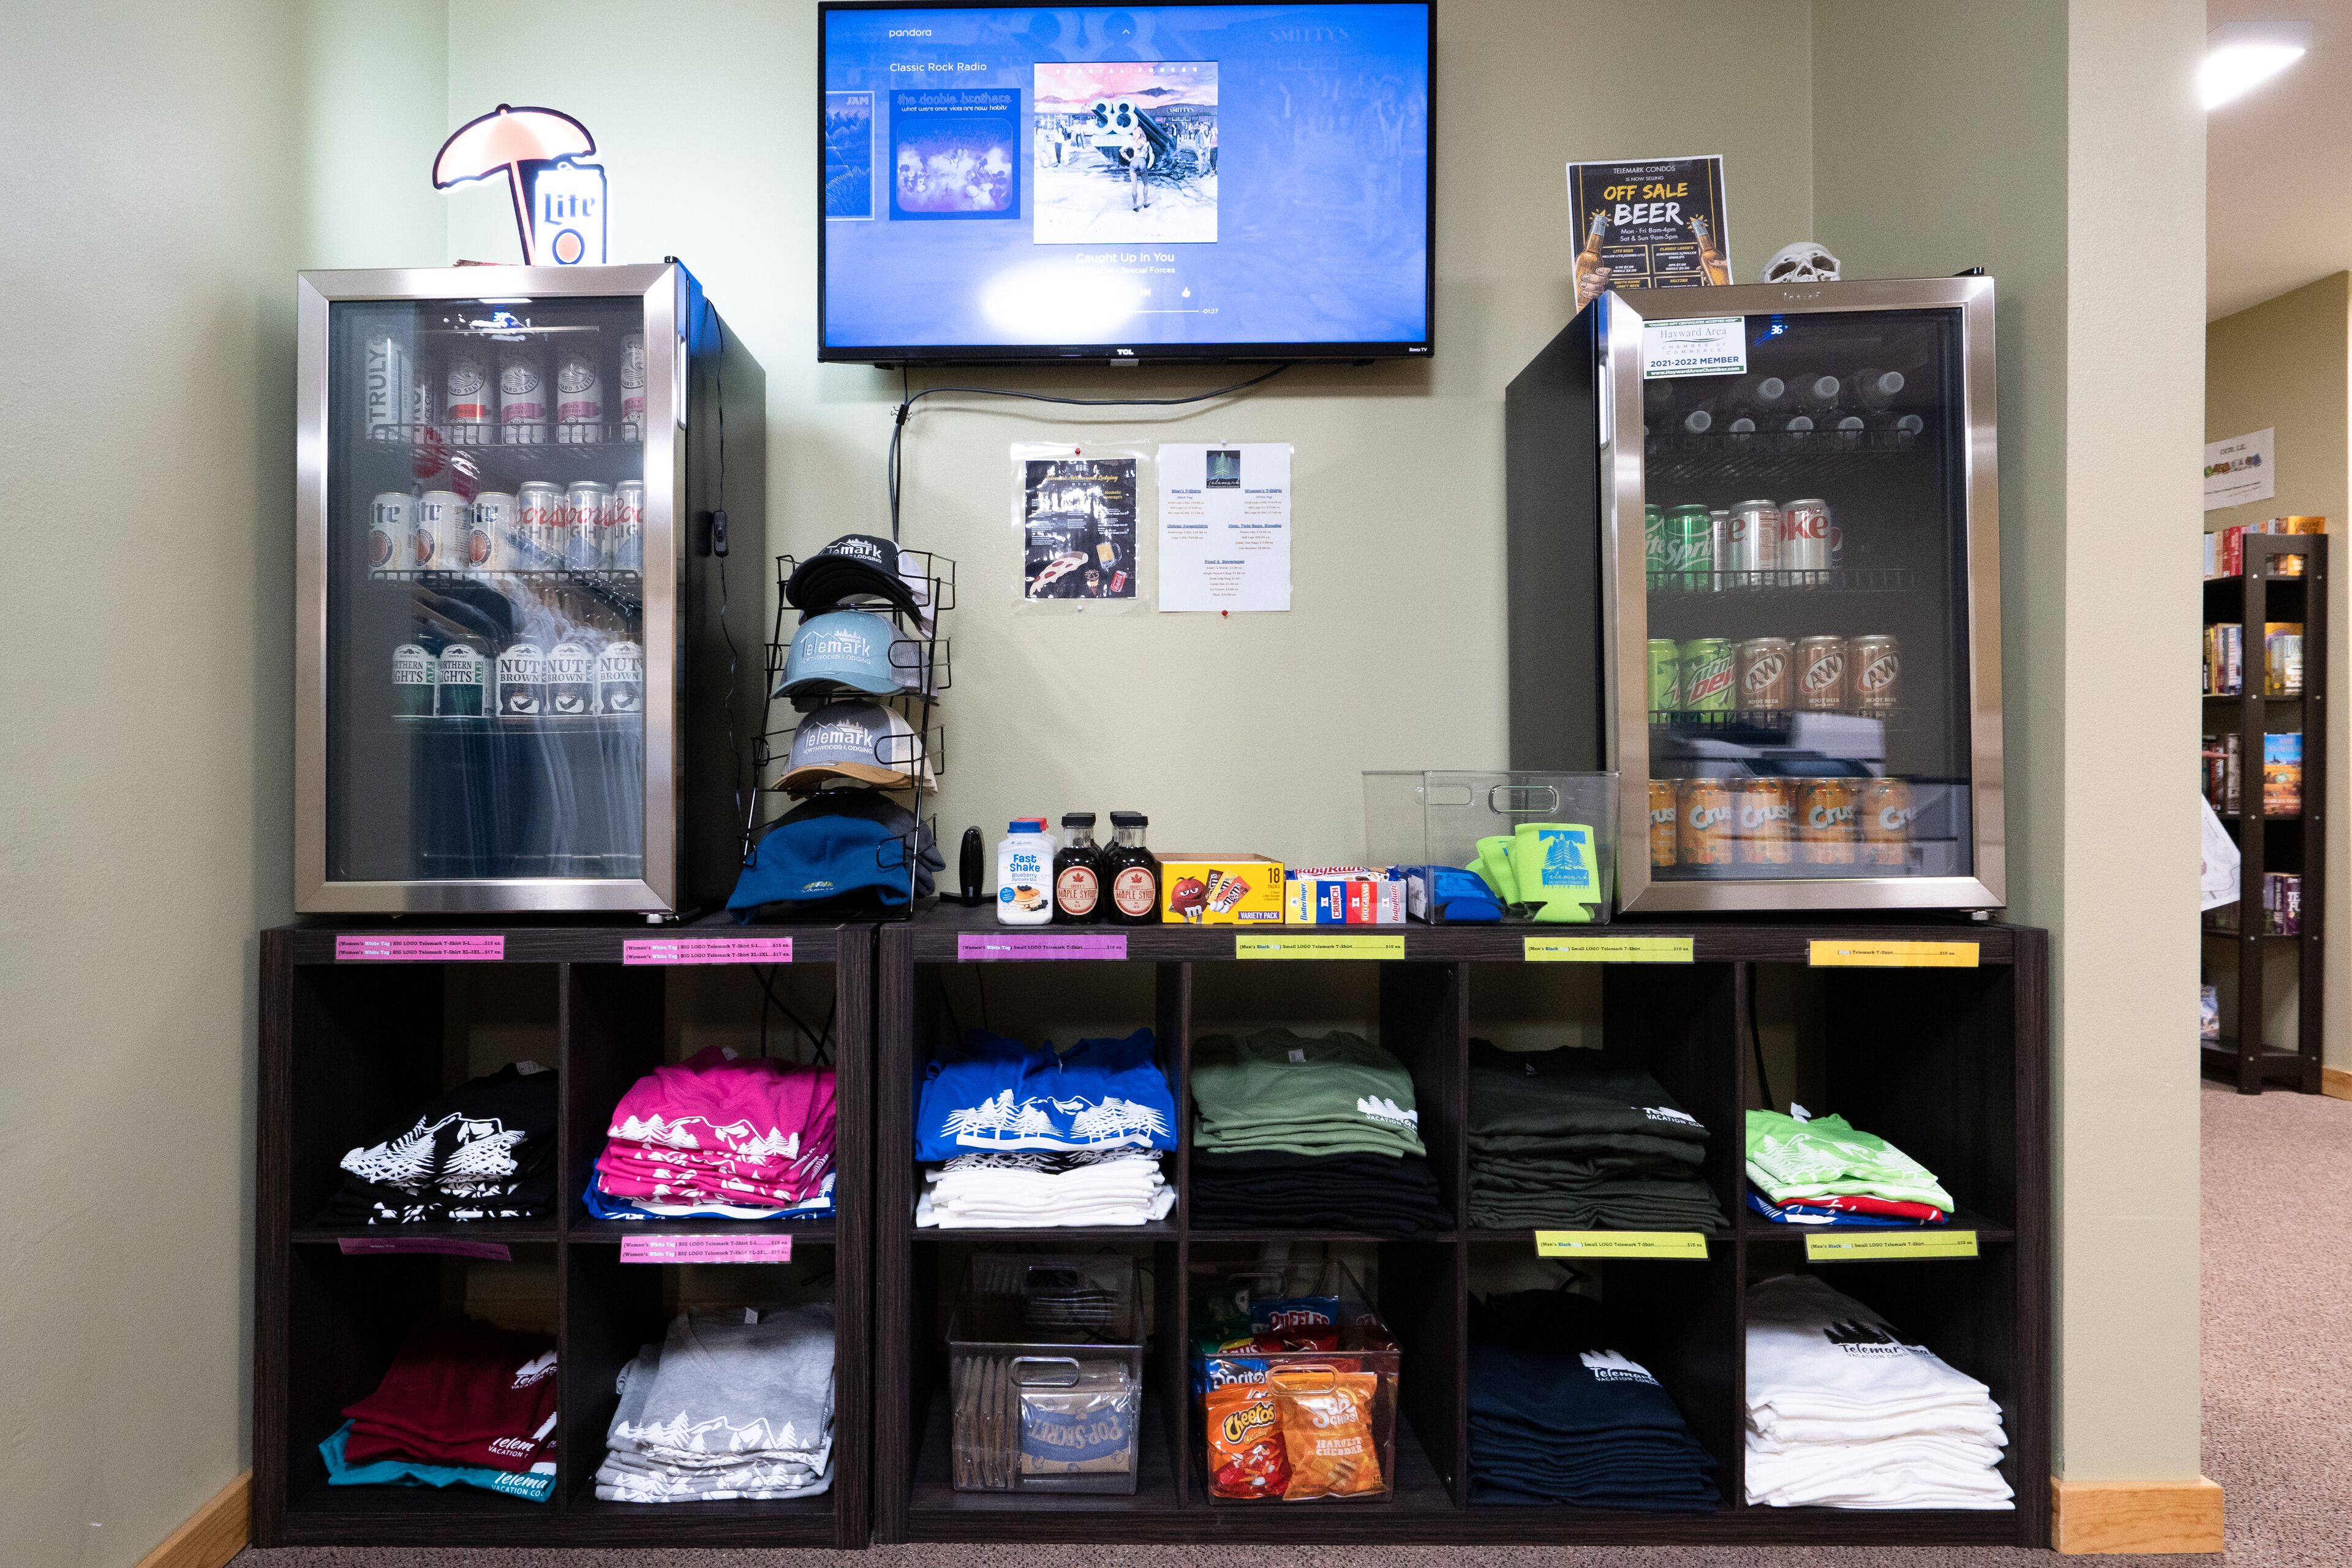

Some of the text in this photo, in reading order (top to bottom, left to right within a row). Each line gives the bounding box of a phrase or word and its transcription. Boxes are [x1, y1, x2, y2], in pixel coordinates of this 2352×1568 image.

[889, 28, 932, 38] pandora
[890, 62, 987, 72] Classic Rock Radio
[846, 96, 869, 105] JAM
[1089, 97, 1139, 135] 38
[1604, 183, 1688, 201] OFF SALE
[544, 193, 595, 226] Lite
[1613, 202, 1683, 226] BEER
[1076, 252, 1174, 264] Caught Up In You
[1661, 328, 1702, 339] Hayward
[369, 349, 386, 423] TRULY
[854, 554, 882, 564] LODGING
[801, 632, 871, 658] Telemark
[600, 658, 641, 671] NUT
[801, 654, 871, 665] NORTHWOODS LODGING
[500, 660, 540, 673] NUT
[548, 660, 583, 673] NUT
[804, 723, 873, 748] Telemark
[803, 745, 873, 755] NORTHWOODS LODGING
[1014, 854, 1036, 863] Fast
[1010, 862, 1040, 872] Shake
[1268, 868, 1280, 883] 18
[1117, 891, 1136, 899] MAPLE
[1366, 1115, 1401, 1126] VACATION
[1646, 1114, 1686, 1124] VACATION
[1223, 1402, 1276, 1444] Cheetos
[1317, 1437, 1362, 1449] HARVEST
[488, 1446, 522, 1457] VACATION
[1316, 1445, 1363, 1456] CHEDDAR
[492, 1485, 527, 1495] VACATION
